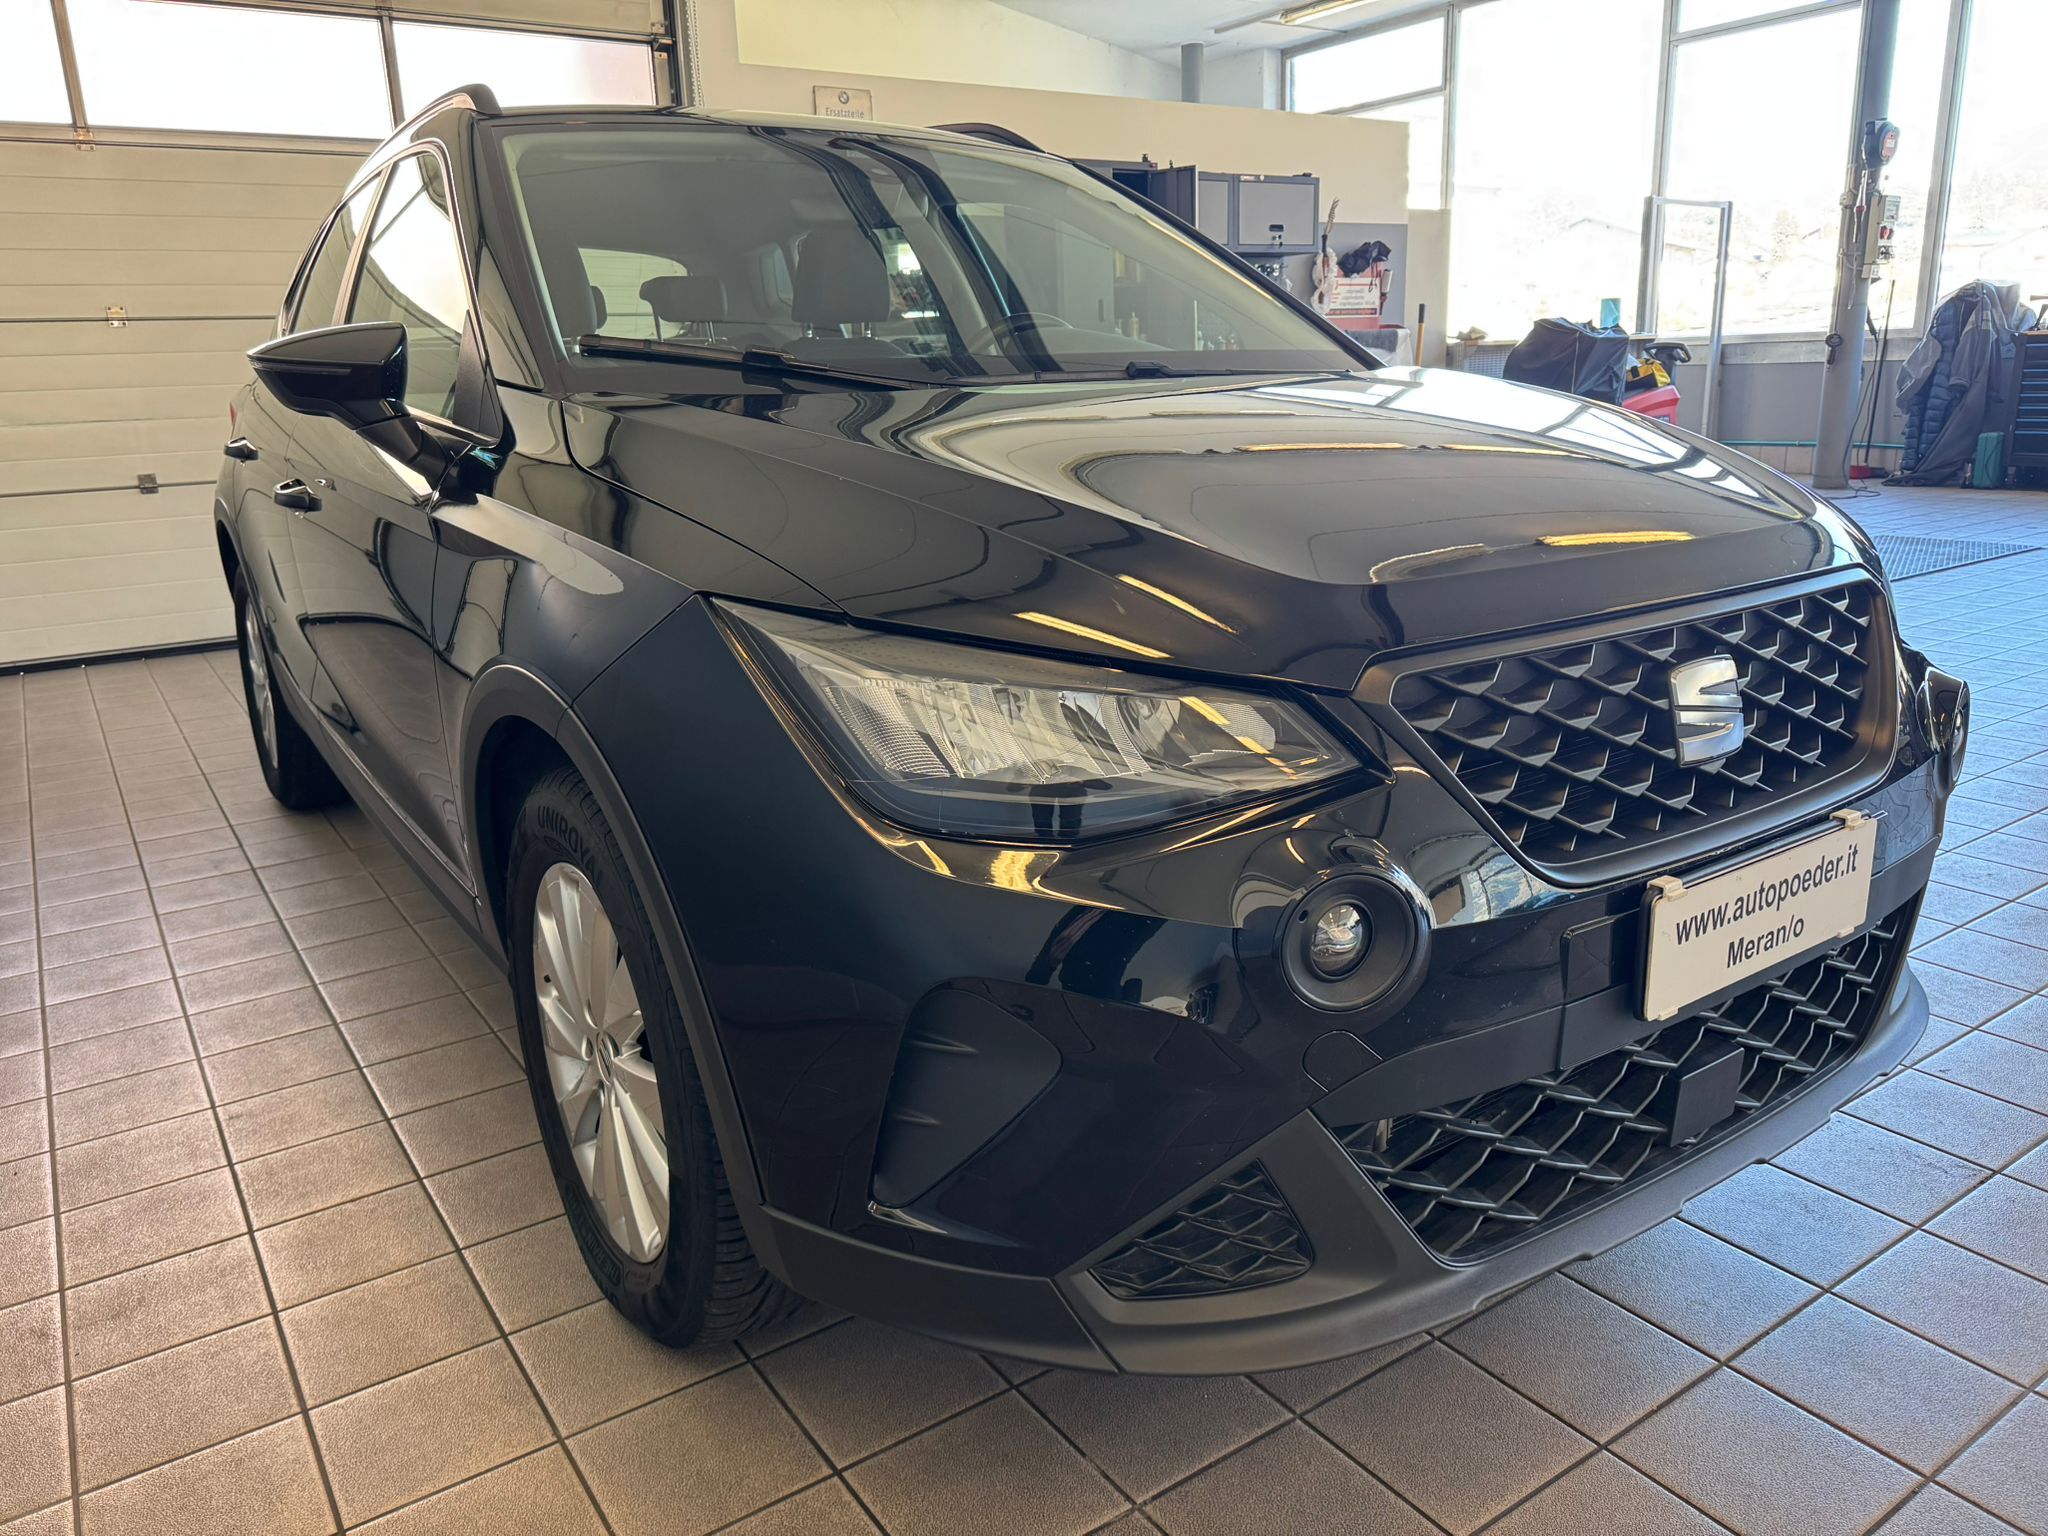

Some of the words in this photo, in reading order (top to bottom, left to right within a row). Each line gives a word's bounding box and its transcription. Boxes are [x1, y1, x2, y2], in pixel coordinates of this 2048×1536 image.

[825, 107, 865, 118] Ersatzteile
[1676, 843, 1858, 945] www.autopoeder.it
[1726, 914, 1804, 968] Meran/o
